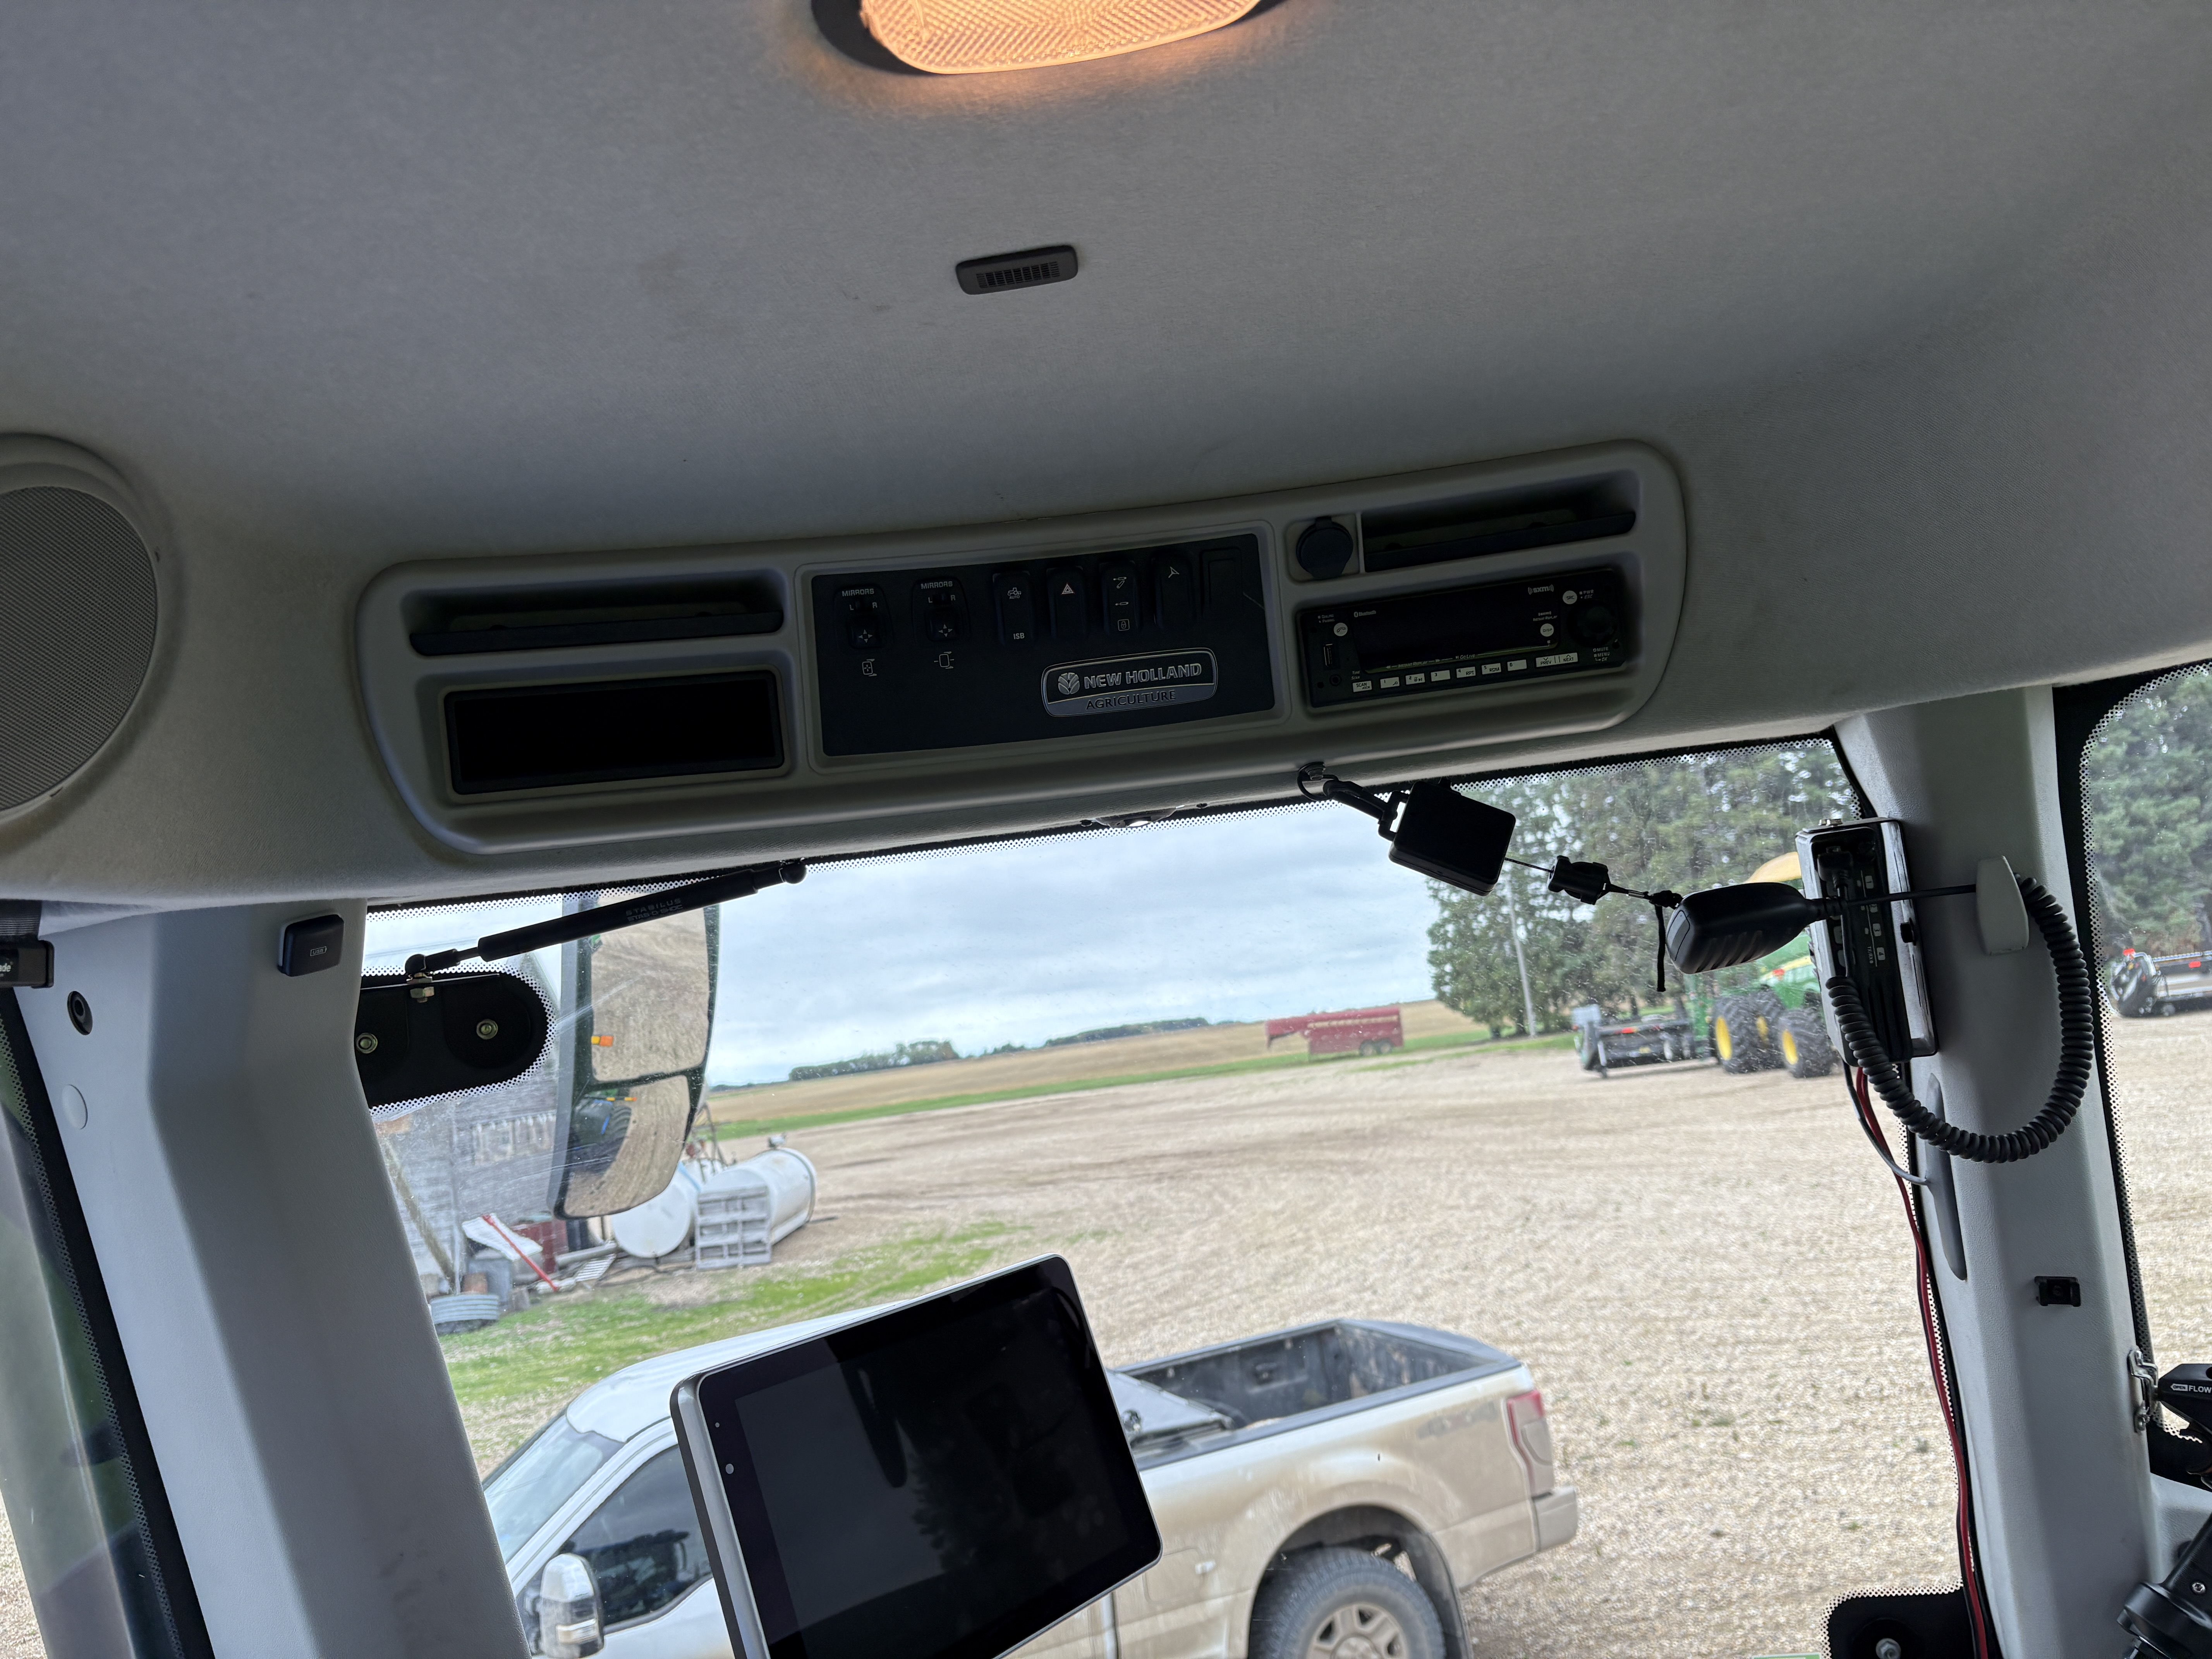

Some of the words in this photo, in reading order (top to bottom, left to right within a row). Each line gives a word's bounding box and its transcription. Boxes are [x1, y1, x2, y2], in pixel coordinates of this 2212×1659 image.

[921, 581, 953, 589] MIRRORS
[842, 588, 874, 596] MIRRORS
[1084, 672, 1121, 689] NEW
[1125, 663, 1202, 684] HOLLAND
[1086, 690, 1176, 710] AGRICULTURE
[626, 898, 681, 916] STABILUS
[2189, 1385, 2212, 1393] FLOW
